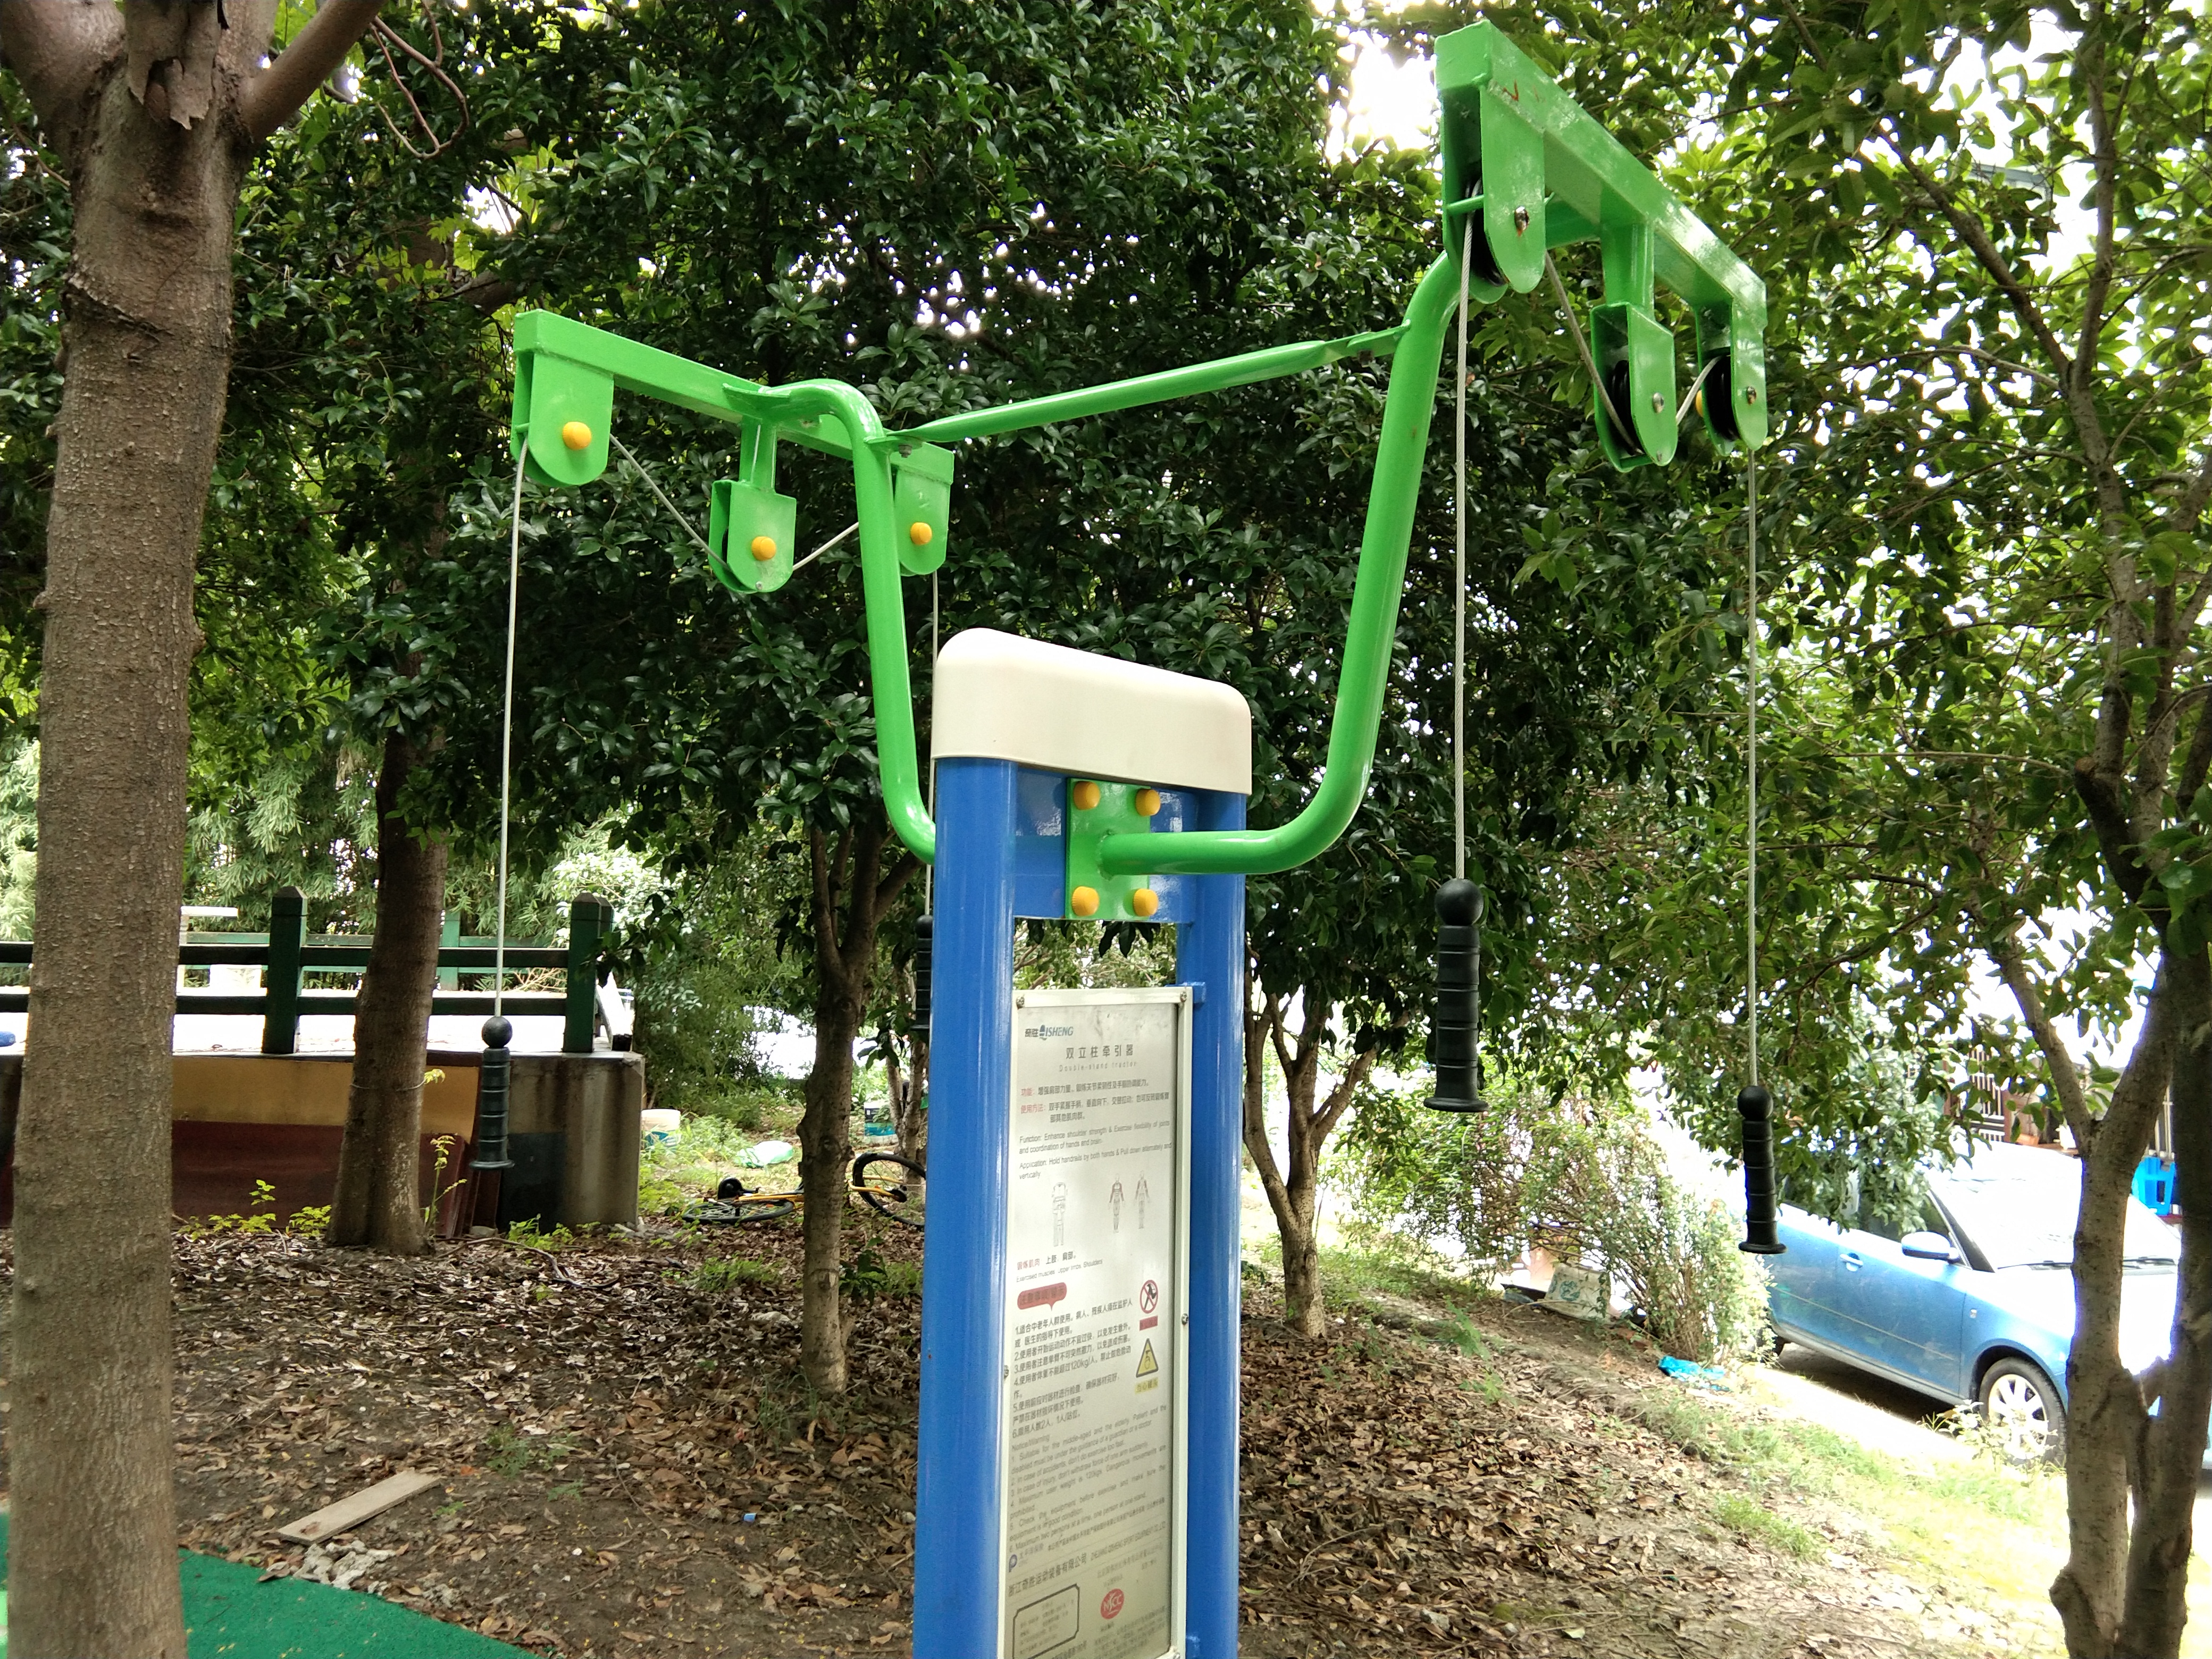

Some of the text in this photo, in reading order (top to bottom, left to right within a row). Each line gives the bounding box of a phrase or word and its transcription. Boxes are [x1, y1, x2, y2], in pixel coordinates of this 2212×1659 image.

[1065, 1044, 1133, 1059] 双立柱牵引器
